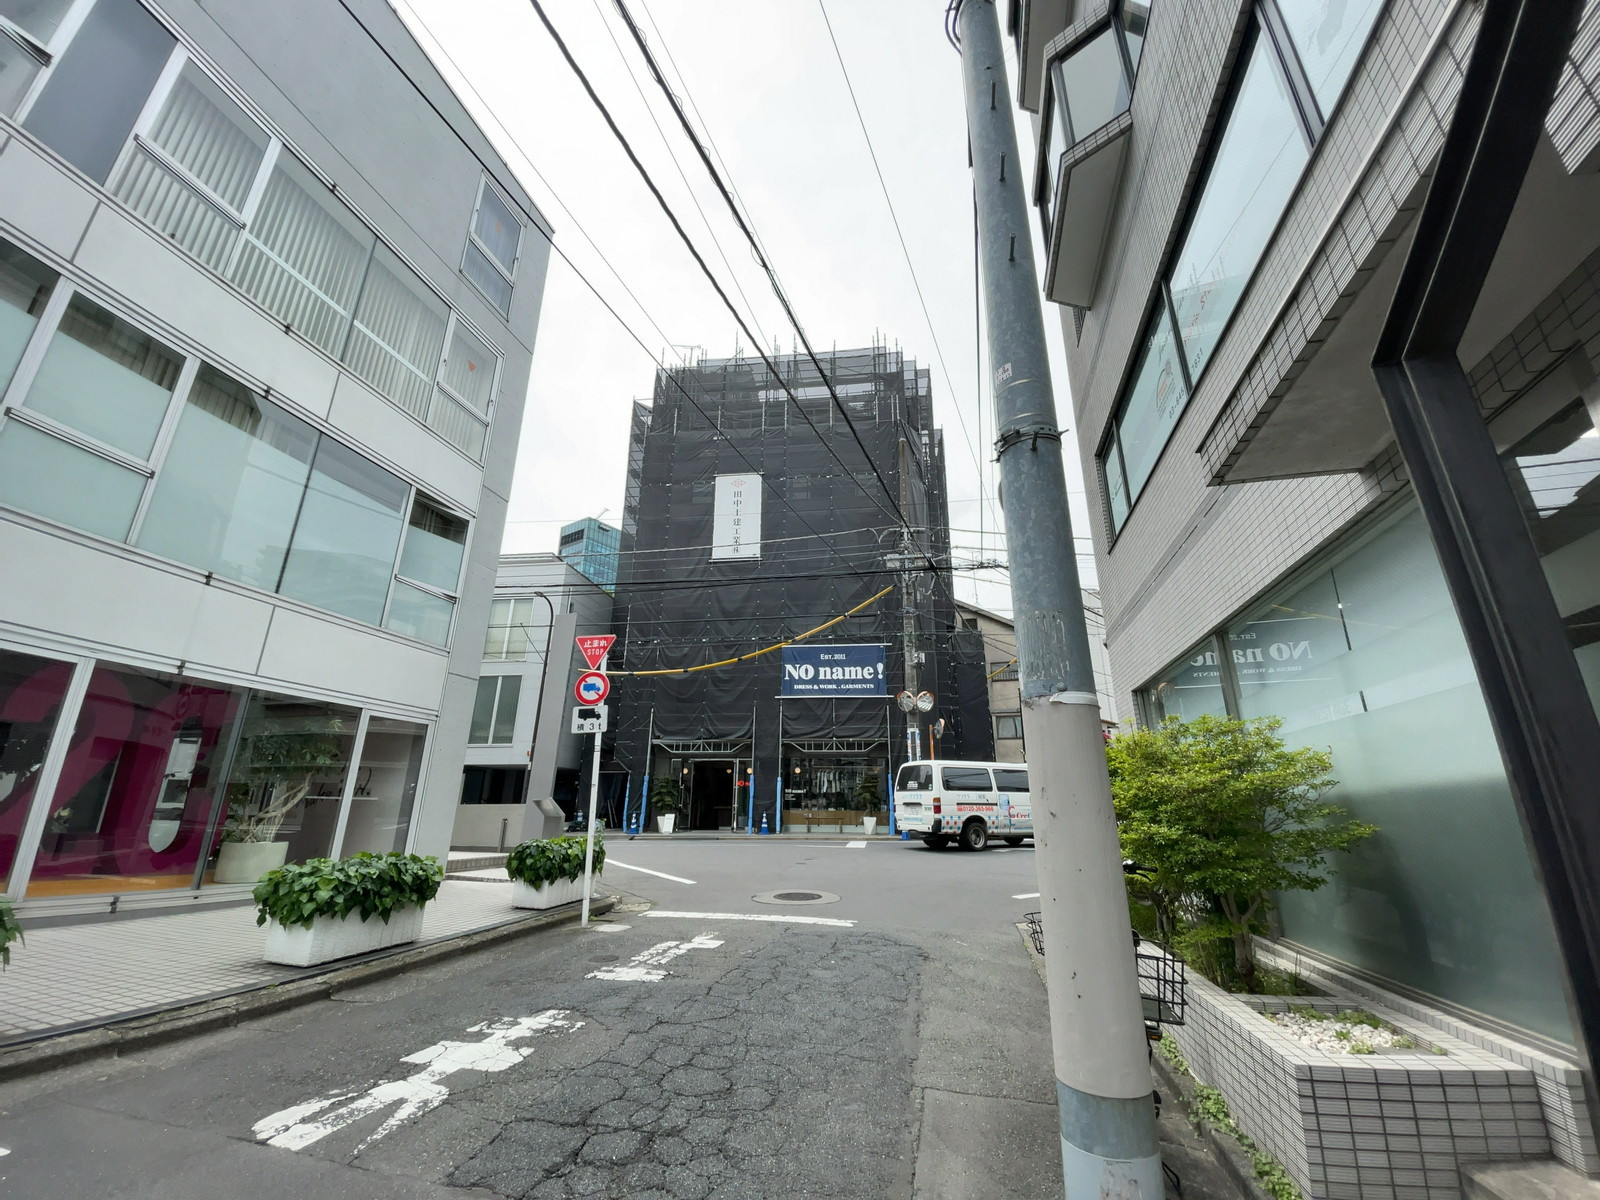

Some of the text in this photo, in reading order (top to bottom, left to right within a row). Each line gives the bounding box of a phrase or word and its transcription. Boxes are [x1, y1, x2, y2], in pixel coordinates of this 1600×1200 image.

[583, 639, 607, 648] 止まれ
[587, 648, 604, 656] STOP
[784, 664, 815, 680] NO
